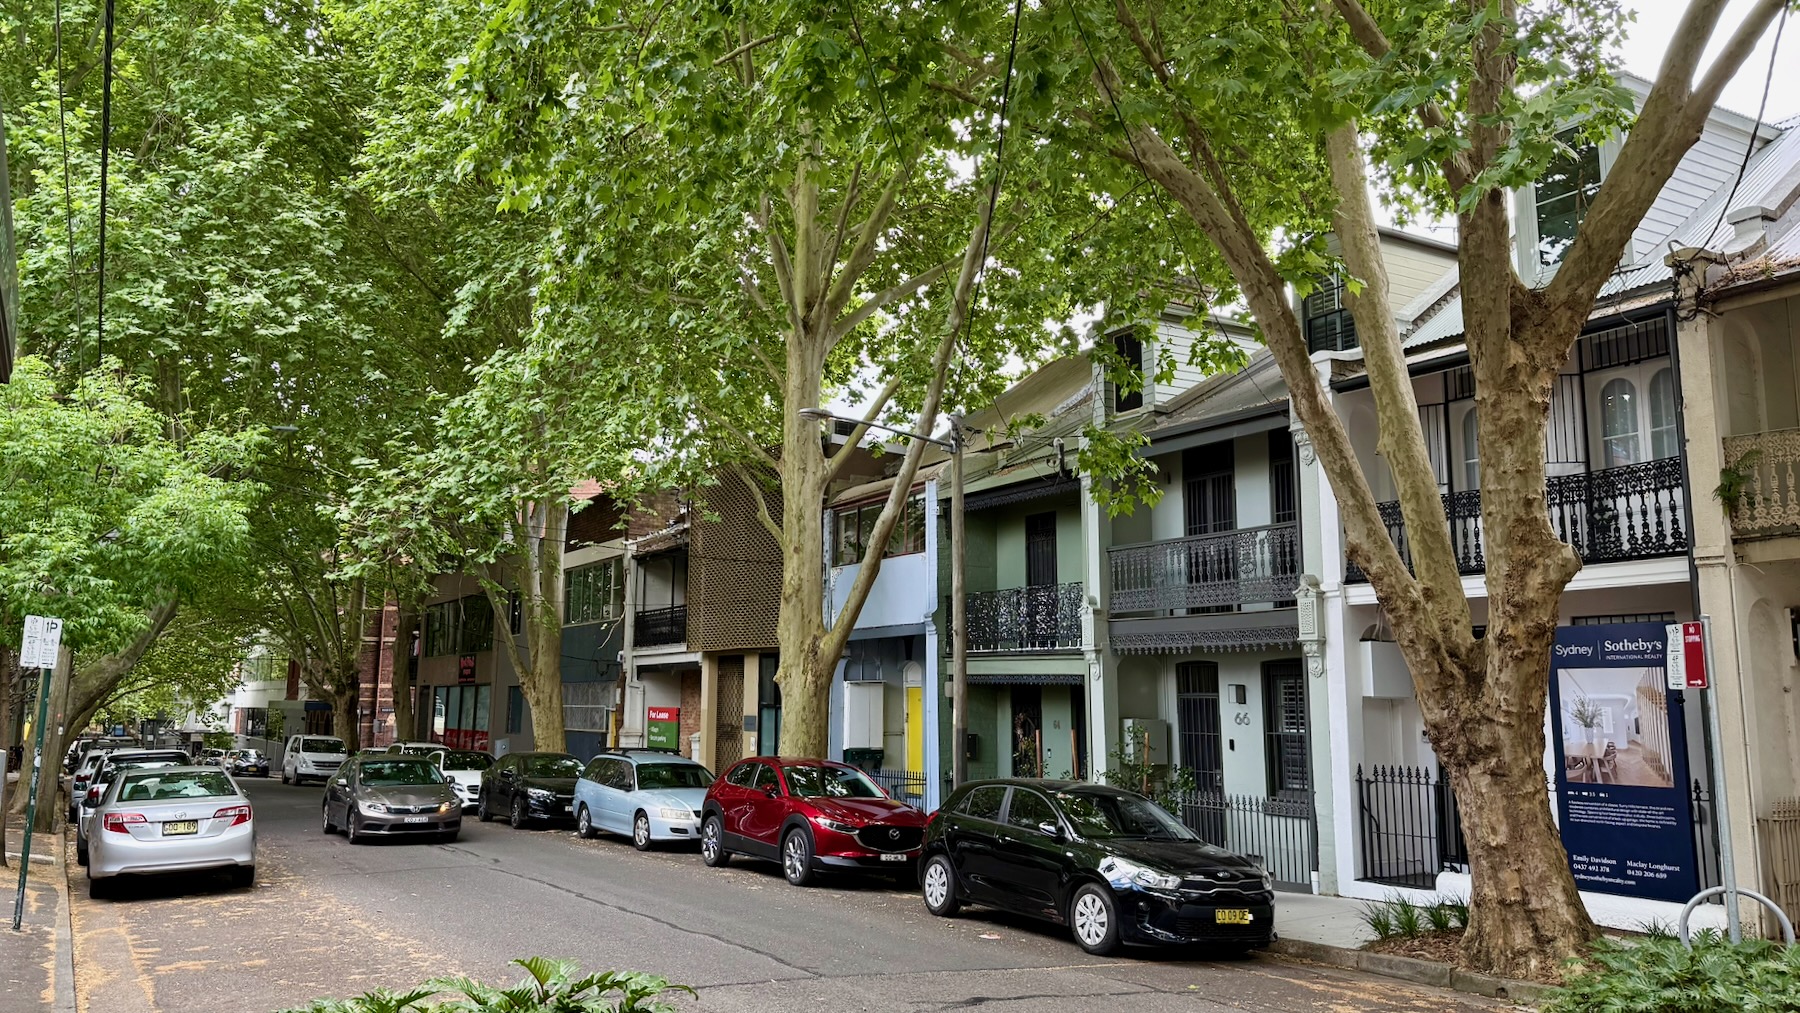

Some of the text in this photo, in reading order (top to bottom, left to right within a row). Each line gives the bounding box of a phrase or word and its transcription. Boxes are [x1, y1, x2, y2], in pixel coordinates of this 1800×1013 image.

[46, 621, 58, 634] 1P
[1555, 644, 1593, 657] Sydney
[1604, 638, 1662, 653] Sotheby's
[656, 710, 669, 719] Lease
[1234, 712, 1251, 726] 66
[1573, 854, 1617, 865] Emily Davidson
[1573, 863, 1587, 871] 0437
[1626, 860, 1680, 872] Maclay Longhurst
[1626, 869, 1643, 877] 0420
[1643, 870, 1655, 878] 206
